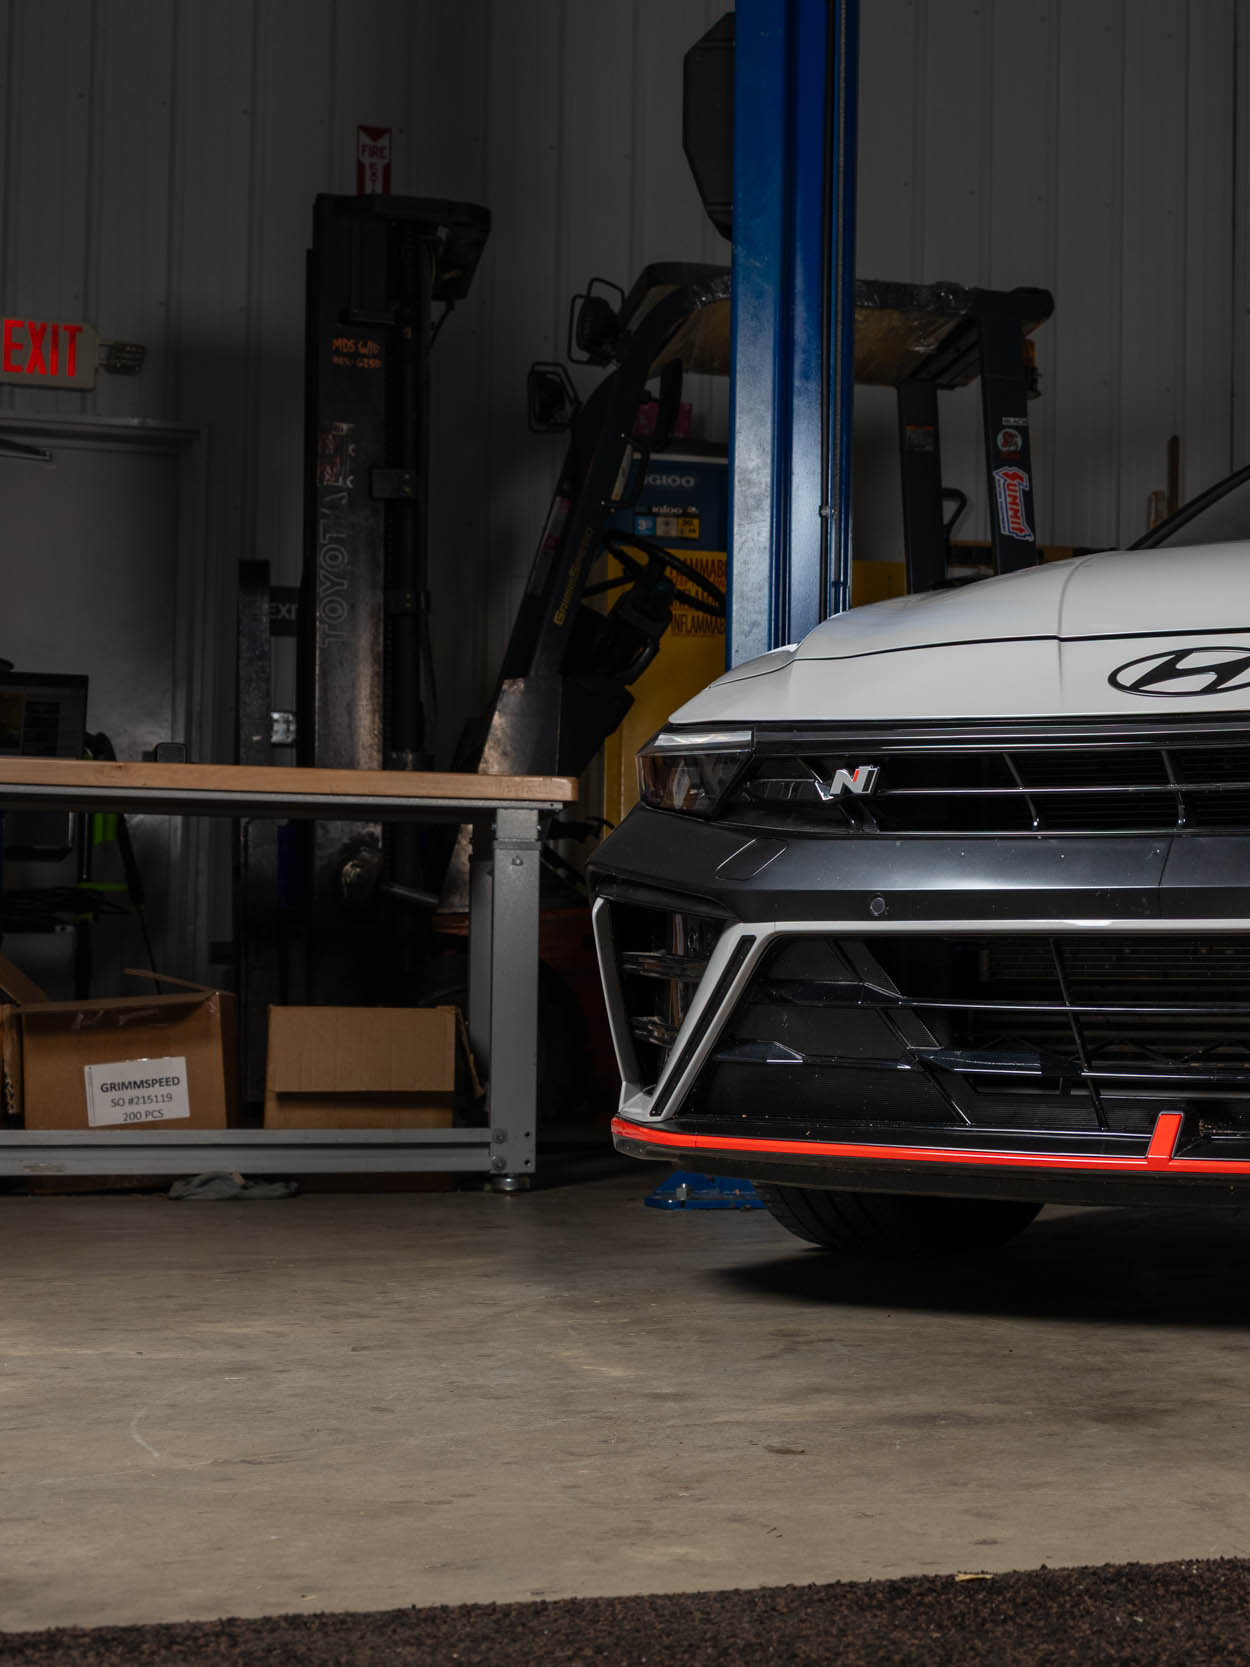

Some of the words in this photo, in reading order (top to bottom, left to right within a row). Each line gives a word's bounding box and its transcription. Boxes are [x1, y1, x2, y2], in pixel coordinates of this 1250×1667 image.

[361, 143, 387, 160] FIRE
[3, 319, 83, 377] EXIT
[319, 491, 349, 649] TOYOTA
[829, 765, 880, 795] N
[100, 1076, 181, 1093] GRIMMSPEED
[111, 1097, 126, 1108] SO
[128, 1092, 173, 1106] #215119
[122, 1111, 142, 1122] 200
[145, 1109, 164, 1119] PCS
